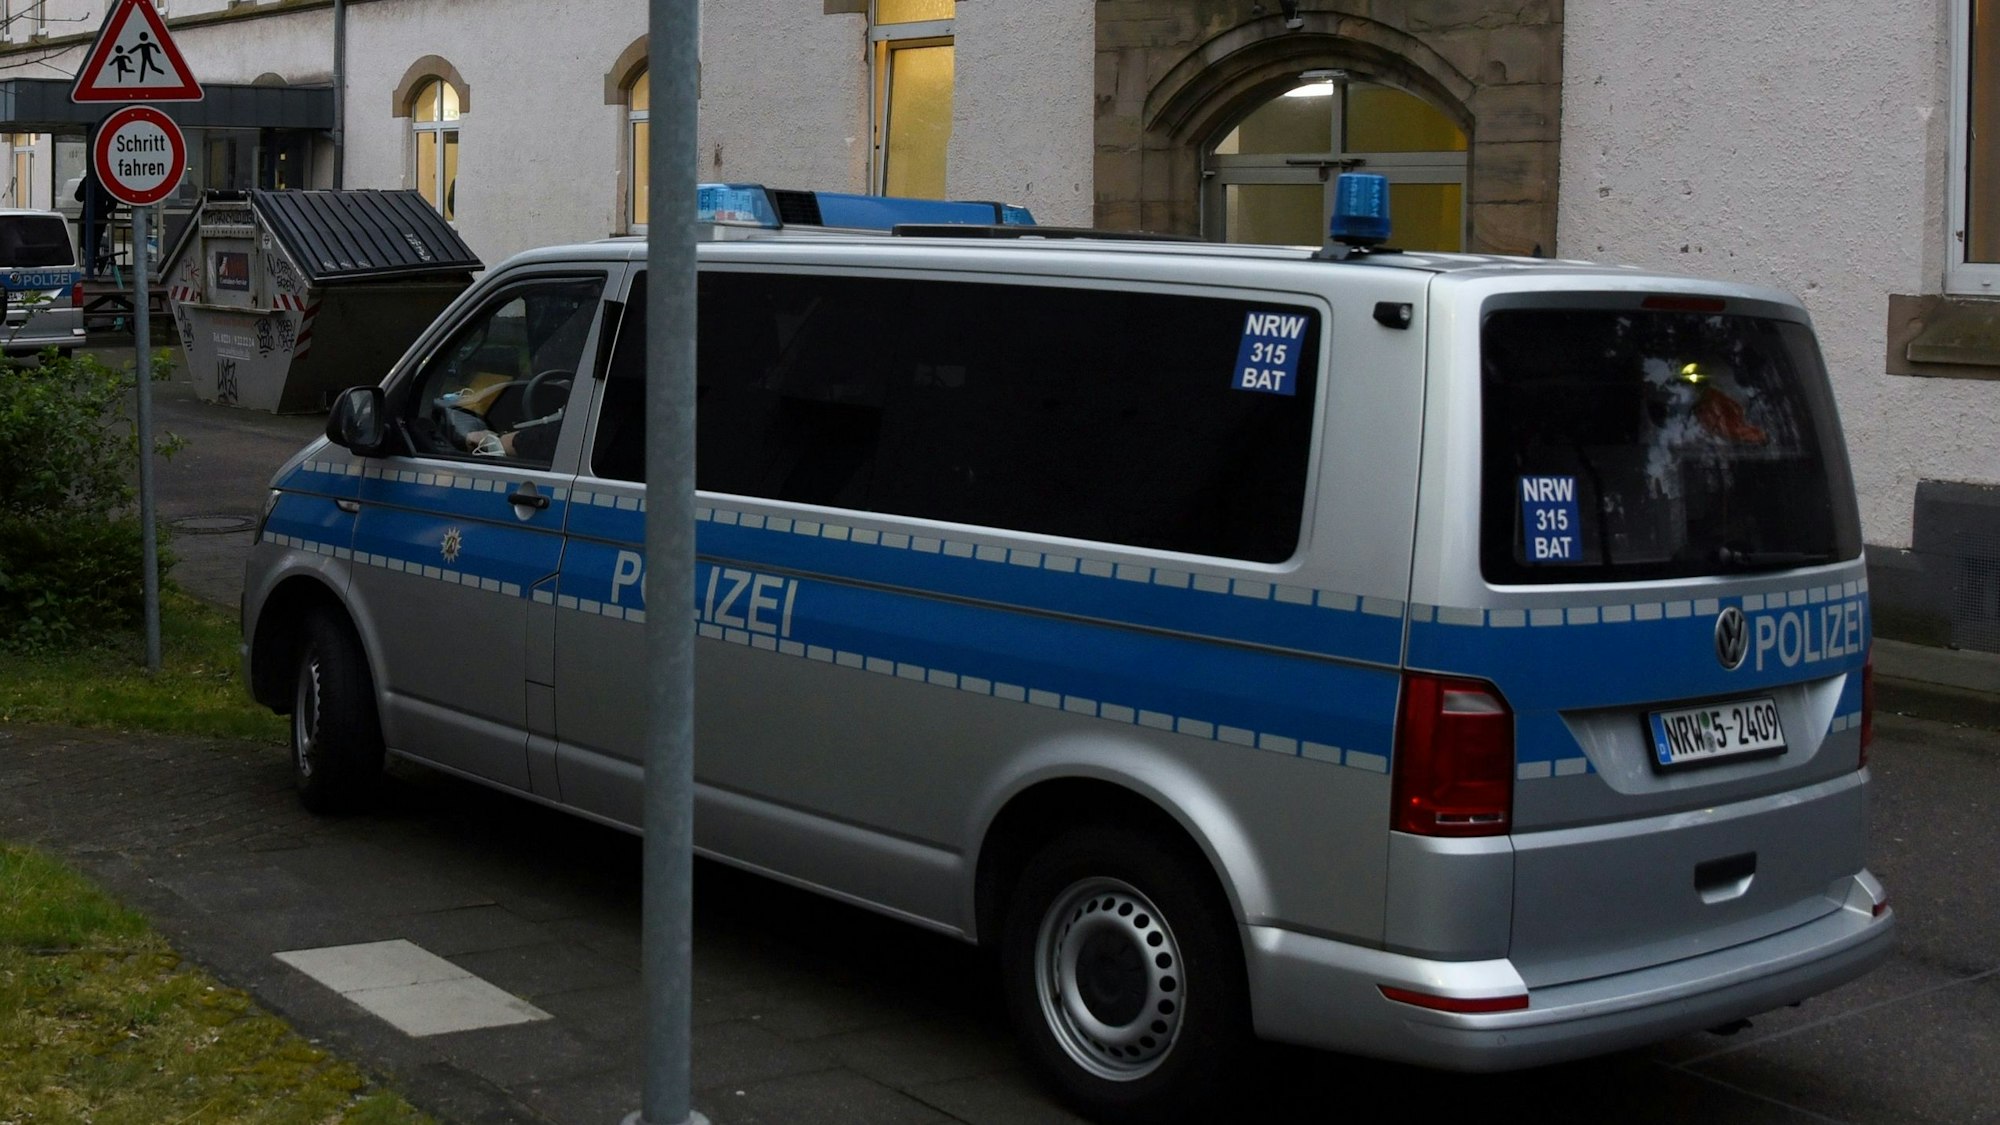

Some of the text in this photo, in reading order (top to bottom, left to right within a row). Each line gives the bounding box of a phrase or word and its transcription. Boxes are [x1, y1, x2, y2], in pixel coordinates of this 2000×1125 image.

[117, 134, 165, 152] Schritt
[118, 159, 164, 176] fahren
[23, 273, 72, 286] POLIZEI
[1246, 313, 1305, 339] NRW
[1250, 342, 1288, 365] 315
[1241, 367, 1286, 391] BAT
[1522, 478, 1573, 502] NRW
[1535, 508, 1568, 531] 315
[1534, 536, 1572, 558] BAT
[610, 550, 799, 638] PIZEI
[1755, 600, 1863, 671] POLIZEI
[1663, 714, 1706, 756] NRW
[1710, 704, 1777, 748] 5-2409
